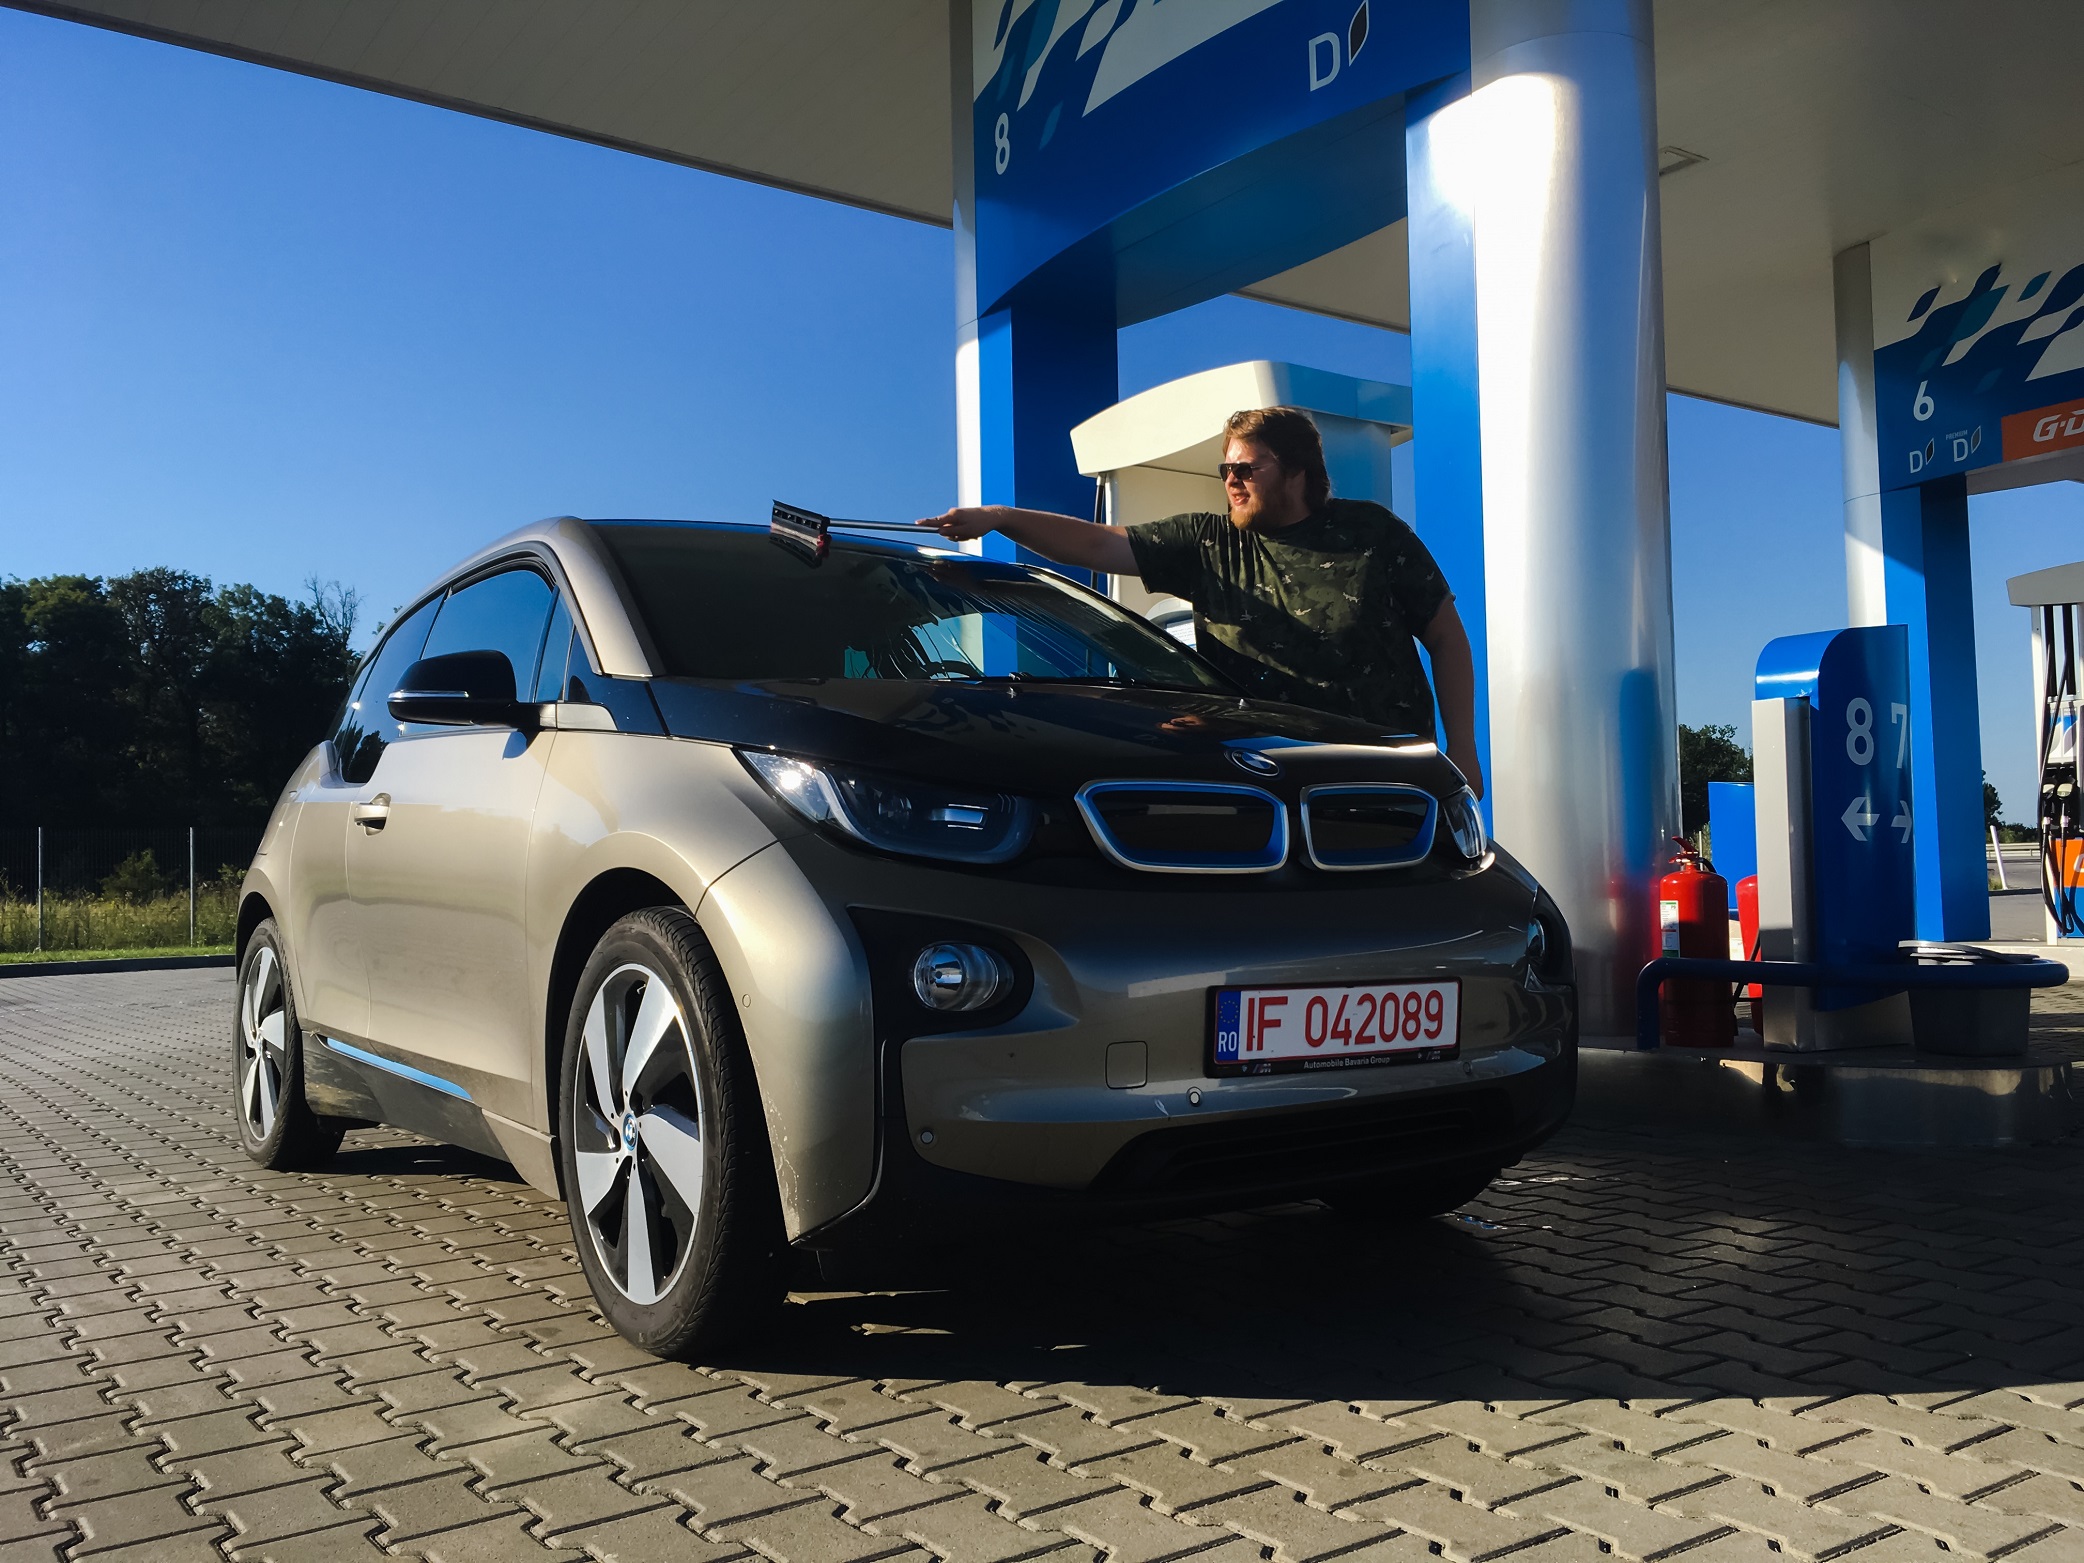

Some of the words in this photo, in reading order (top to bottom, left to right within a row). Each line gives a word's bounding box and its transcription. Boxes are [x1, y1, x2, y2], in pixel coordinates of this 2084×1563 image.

[1308, 31, 1341, 92] D
[994, 112, 1011, 175] 8
[1913, 379, 1935, 422] 6
[1945, 429, 1968, 441] PREMIUM
[1953, 438, 1969, 463] D
[1909, 450, 1924, 474] D
[1846, 697, 1875, 766] 8
[1891, 702, 1908, 769] 7
[1246, 996, 1288, 1052] IF
[1305, 989, 1444, 1048] 042089
[1217, 1031, 1238, 1053] RO
[1303, 1058, 1344, 1069] Automobile
[1344, 1056, 1369, 1066] Bavaria
[1370, 1055, 1391, 1065] Group
